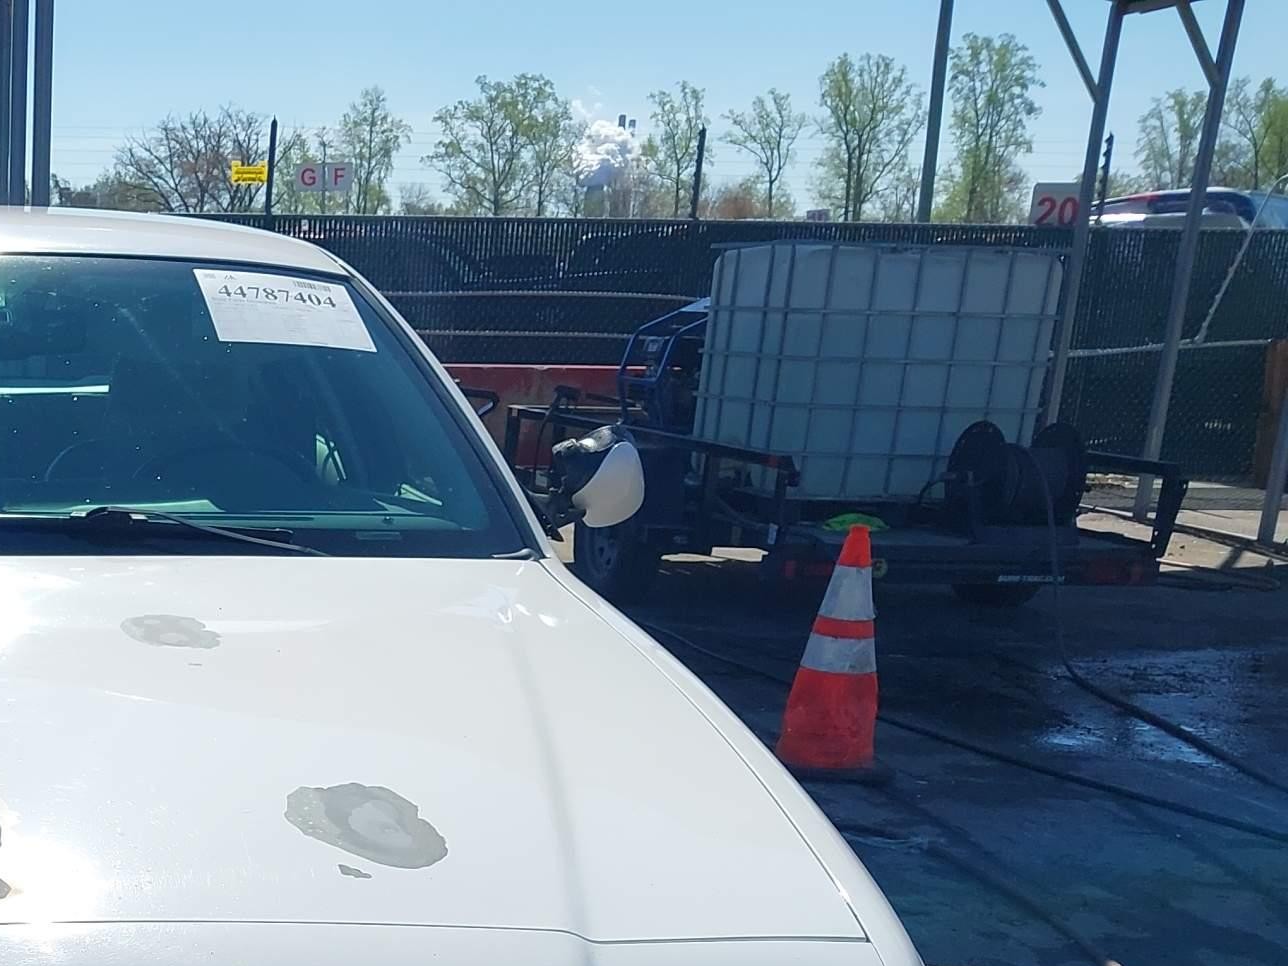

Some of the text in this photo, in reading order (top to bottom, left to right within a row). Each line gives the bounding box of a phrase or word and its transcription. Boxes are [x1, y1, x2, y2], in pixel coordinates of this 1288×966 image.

[300, 167, 317, 186] G
[333, 167, 346, 186] F
[1034, 196, 1080, 225] 20
[217, 284, 337, 309] 44787404
